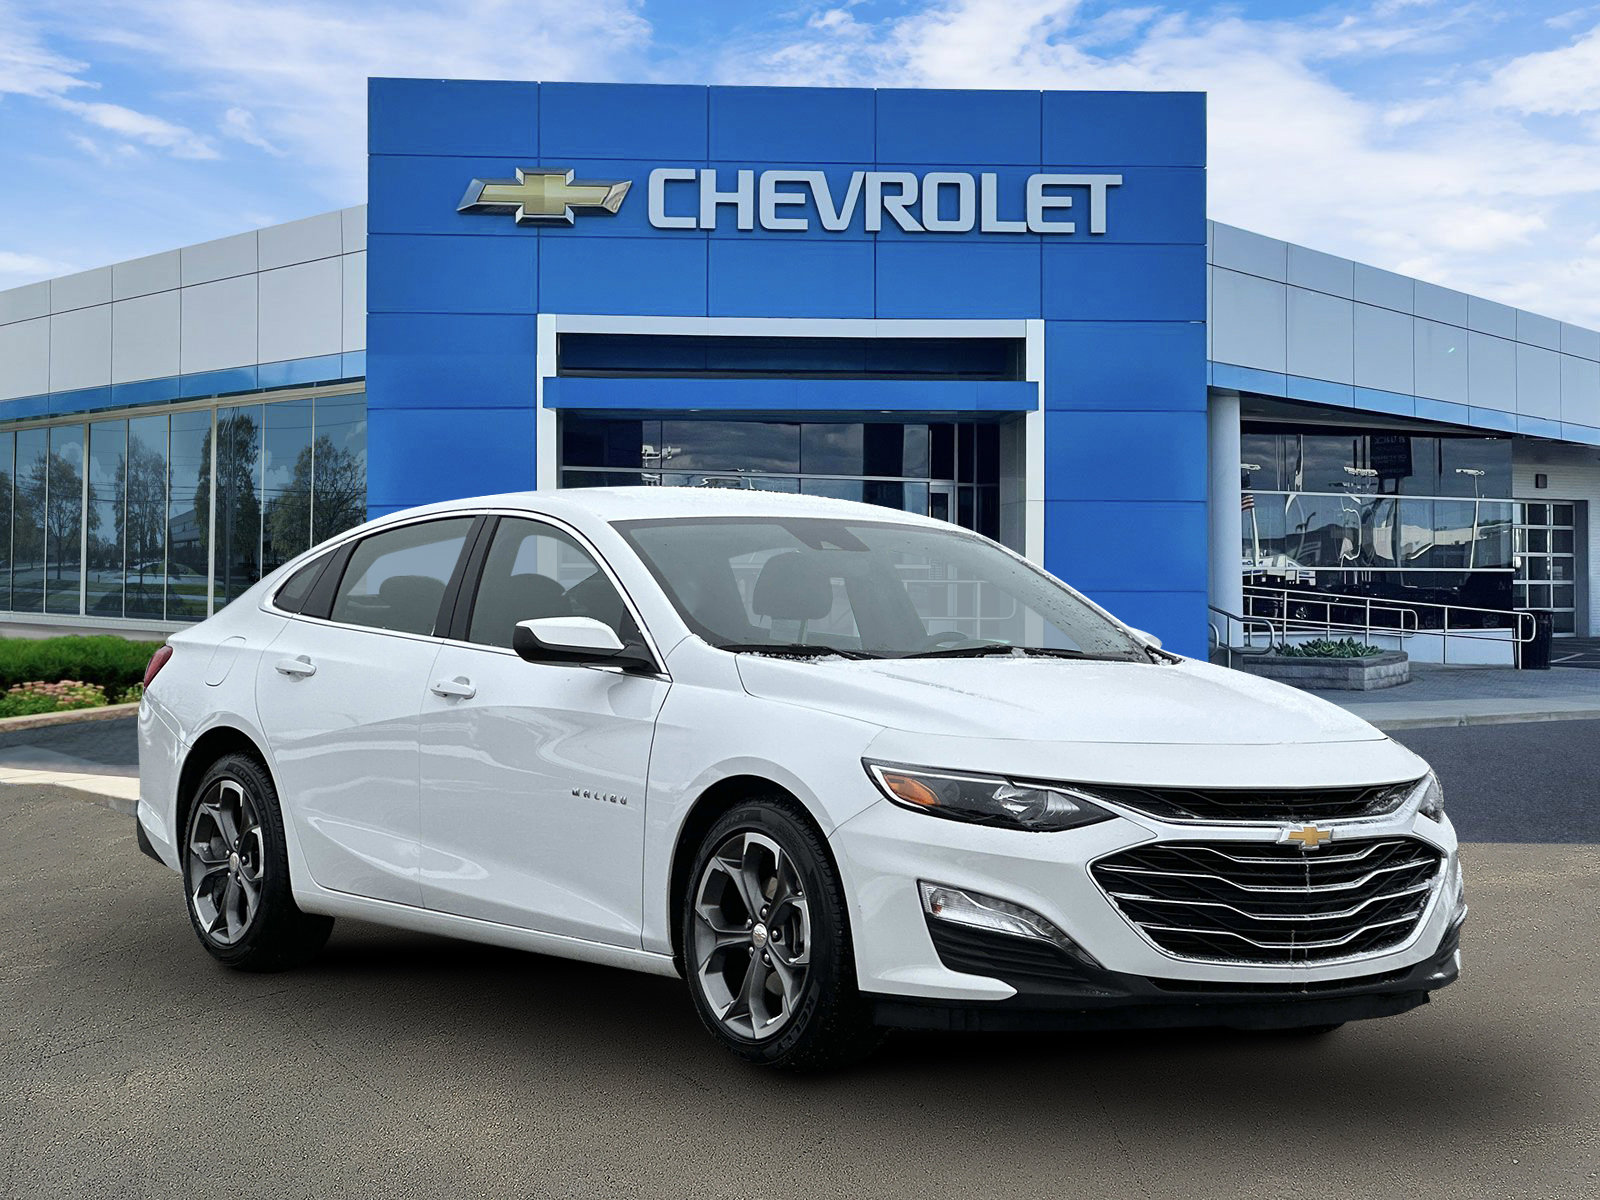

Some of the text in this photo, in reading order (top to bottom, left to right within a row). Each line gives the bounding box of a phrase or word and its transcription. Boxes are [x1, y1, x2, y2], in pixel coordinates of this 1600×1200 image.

[648, 167, 1123, 235] CHEVROLET
[571, 787, 628, 805] MALIBU
[777, 994, 815, 1054] KELLY
